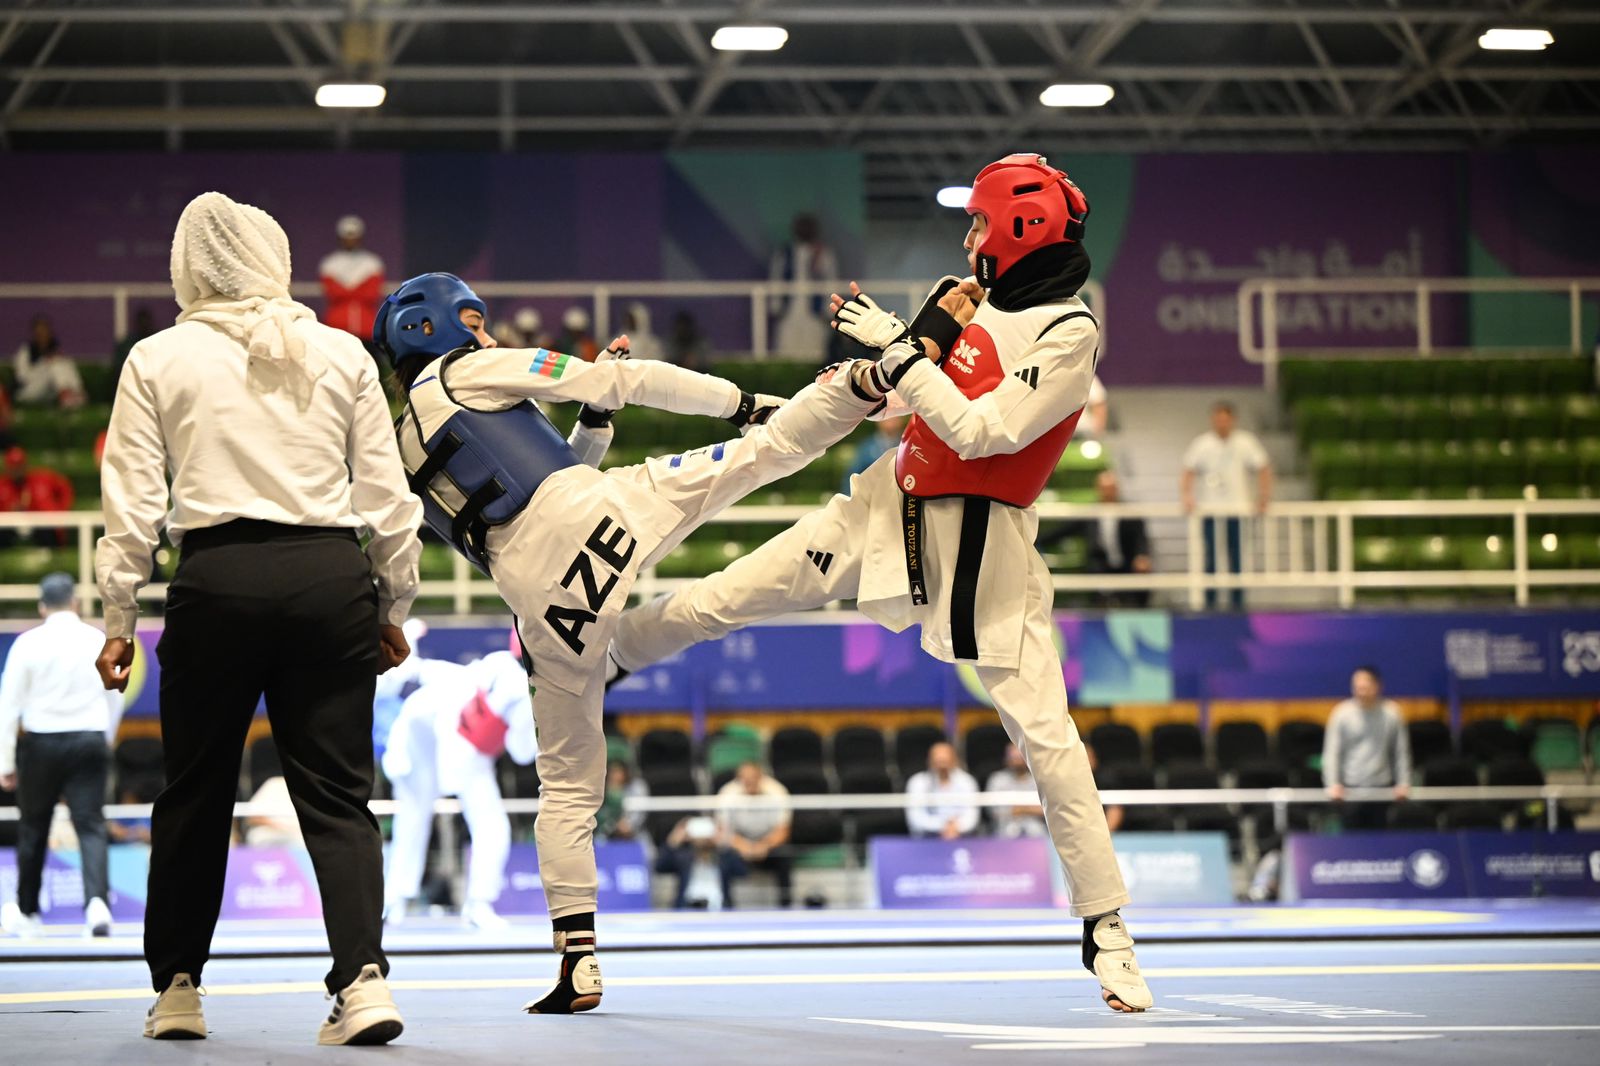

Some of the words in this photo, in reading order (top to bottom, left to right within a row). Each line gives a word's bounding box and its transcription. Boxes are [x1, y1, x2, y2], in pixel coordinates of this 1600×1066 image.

[949, 355, 973, 375] KPNP
[907, 523, 918, 571] TOUZANI
[543, 514, 638, 657] AZE
[1122, 962, 1130, 970] K2
